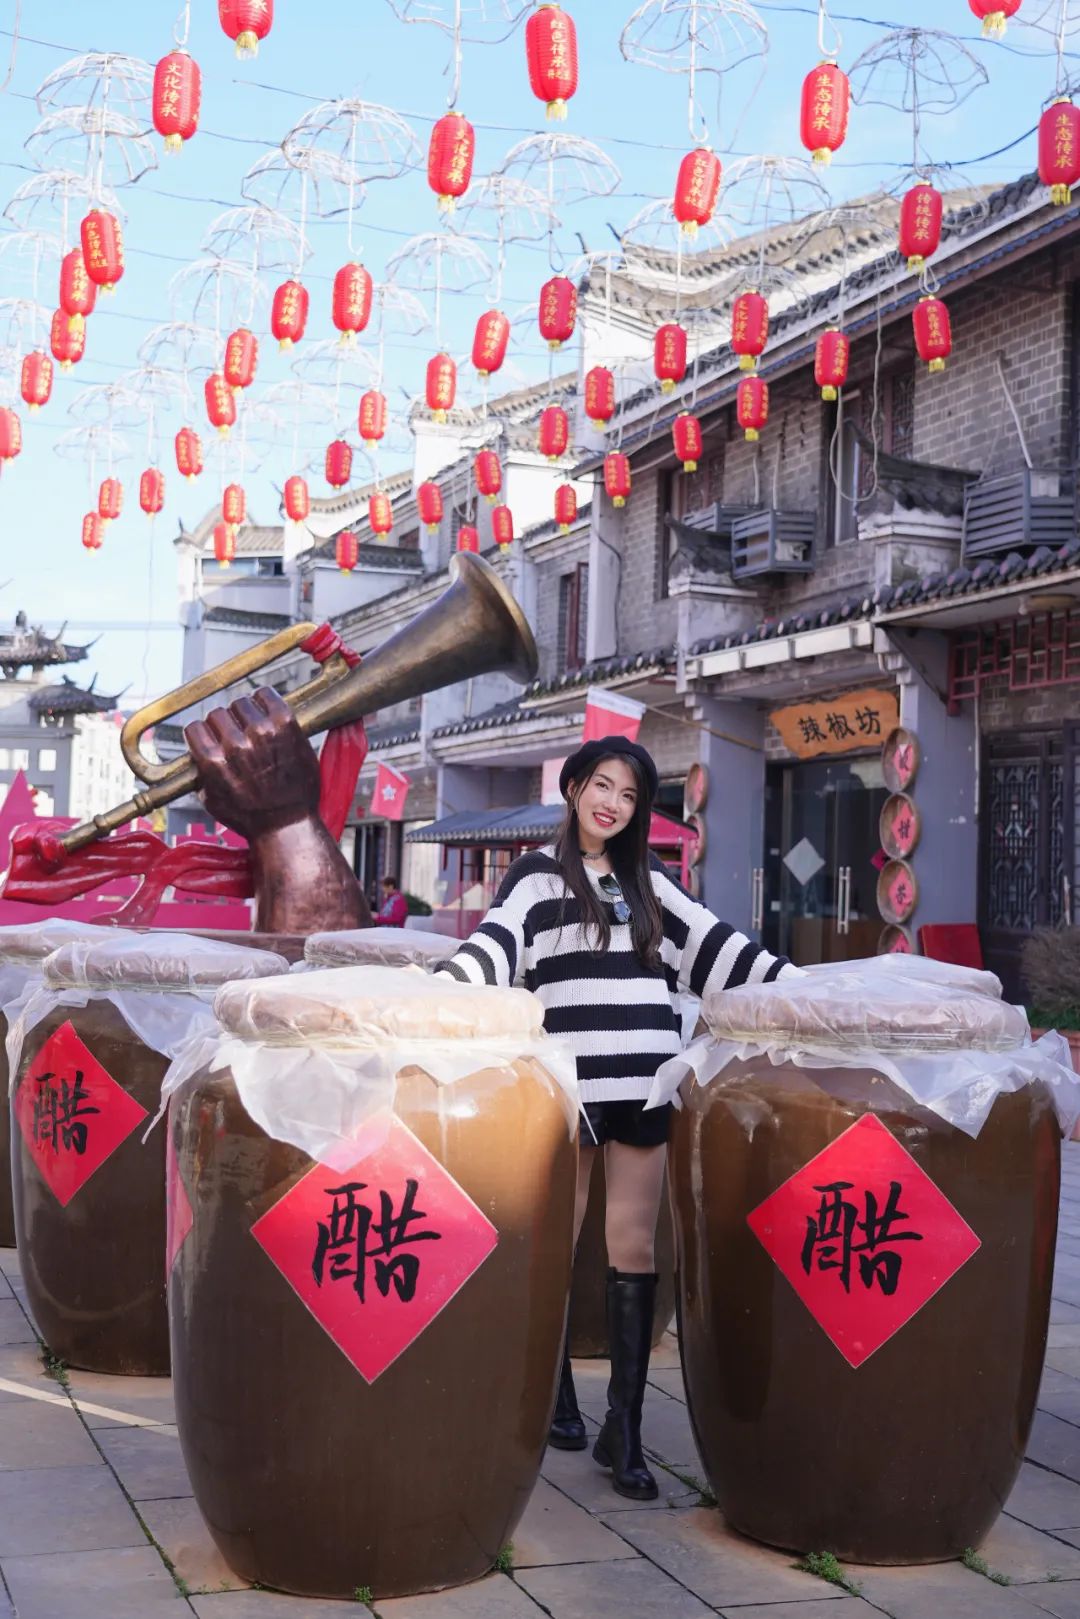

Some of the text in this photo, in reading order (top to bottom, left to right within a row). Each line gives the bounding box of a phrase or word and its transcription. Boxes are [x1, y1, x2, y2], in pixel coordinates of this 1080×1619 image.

[550, 19, 567, 68] 红色传承
[162, 63, 183, 118] 文化传承
[812, 74, 833, 131] 生态传承
[448, 130, 470, 184] 文化传承
[1054, 114, 1074, 168] 生态传承
[913, 193, 932, 240] 传统传承
[279, 287, 300, 326] 传统传承
[349, 271, 366, 315] 文化传承
[543, 284, 558, 327] 生态传承
[481, 319, 503, 360] 传统传承
[735, 299, 749, 342] 文化传承
[798, 706, 881, 743] 辣椒坊
[33, 1070, 100, 1155] 醋
[312, 1178, 441, 1305] 醋
[801, 1181, 923, 1297] 醋
